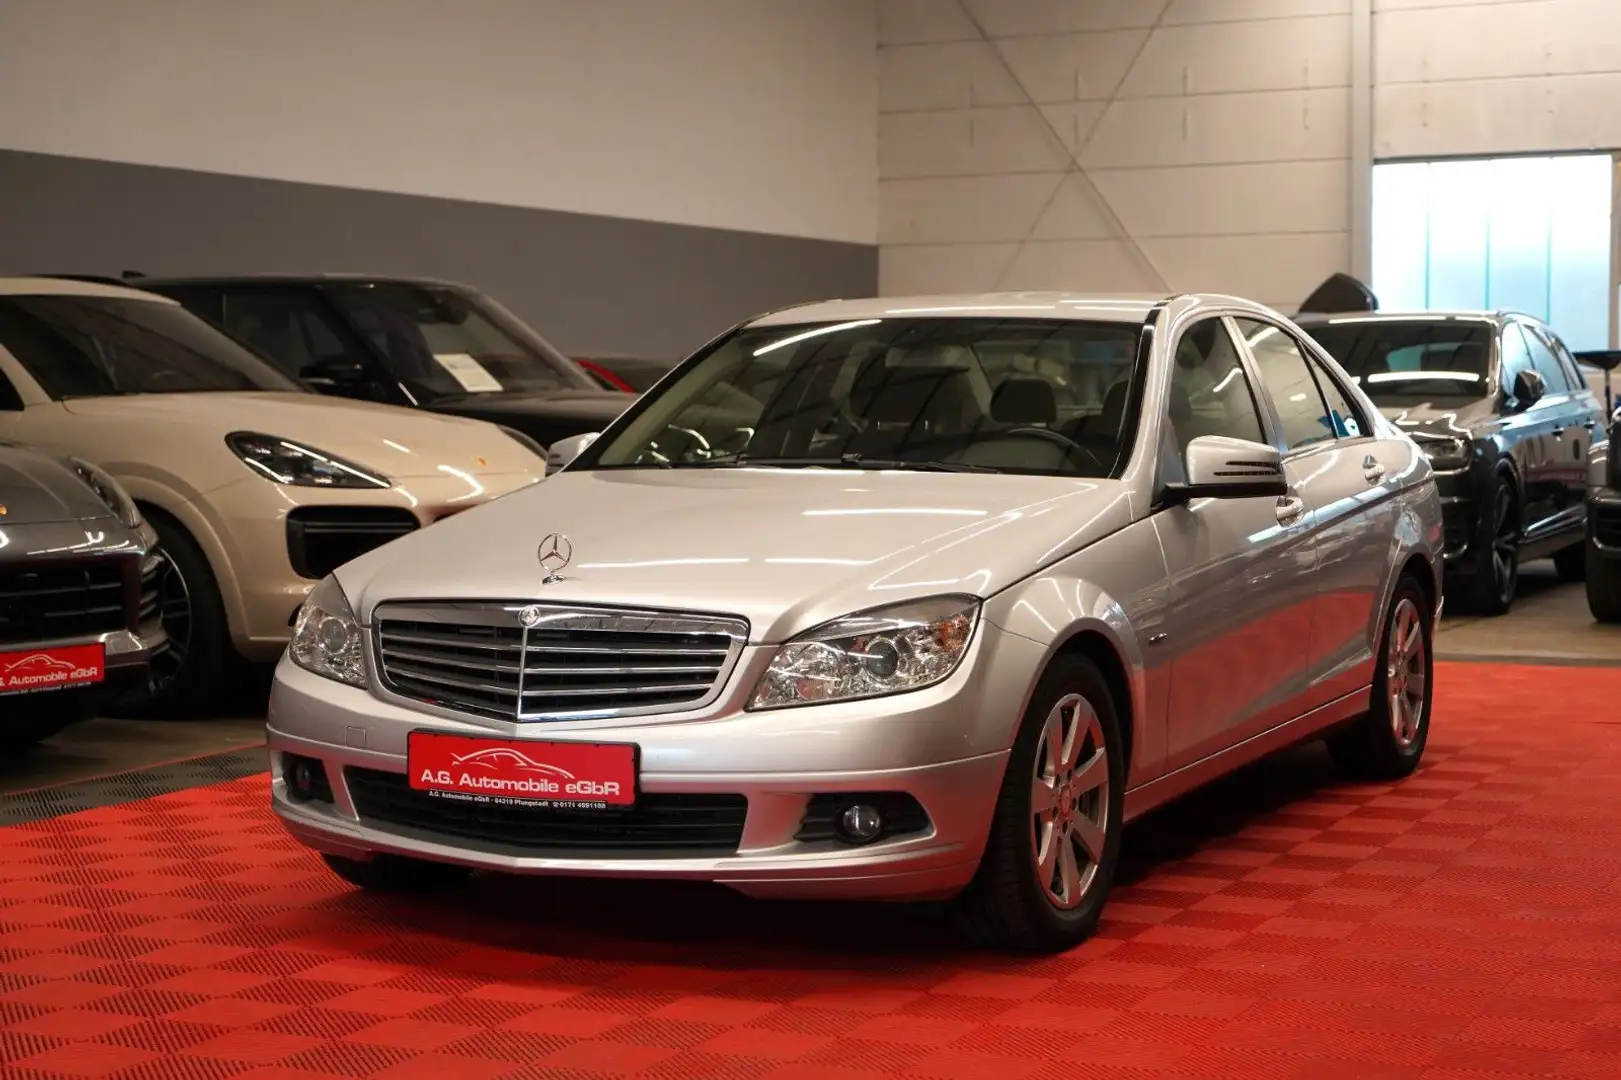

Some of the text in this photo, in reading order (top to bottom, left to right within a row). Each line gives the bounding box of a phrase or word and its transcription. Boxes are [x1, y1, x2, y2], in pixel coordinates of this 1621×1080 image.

[8, 670, 68, 685] Automobile
[70, 667, 98, 679] eGbR
[420, 769, 621, 796] A.G. Automobile eGbR
[441, 792, 473, 801] Automobile
[494, 797, 514, 805] 64319
[514, 799, 549, 807] Pfungstadt
